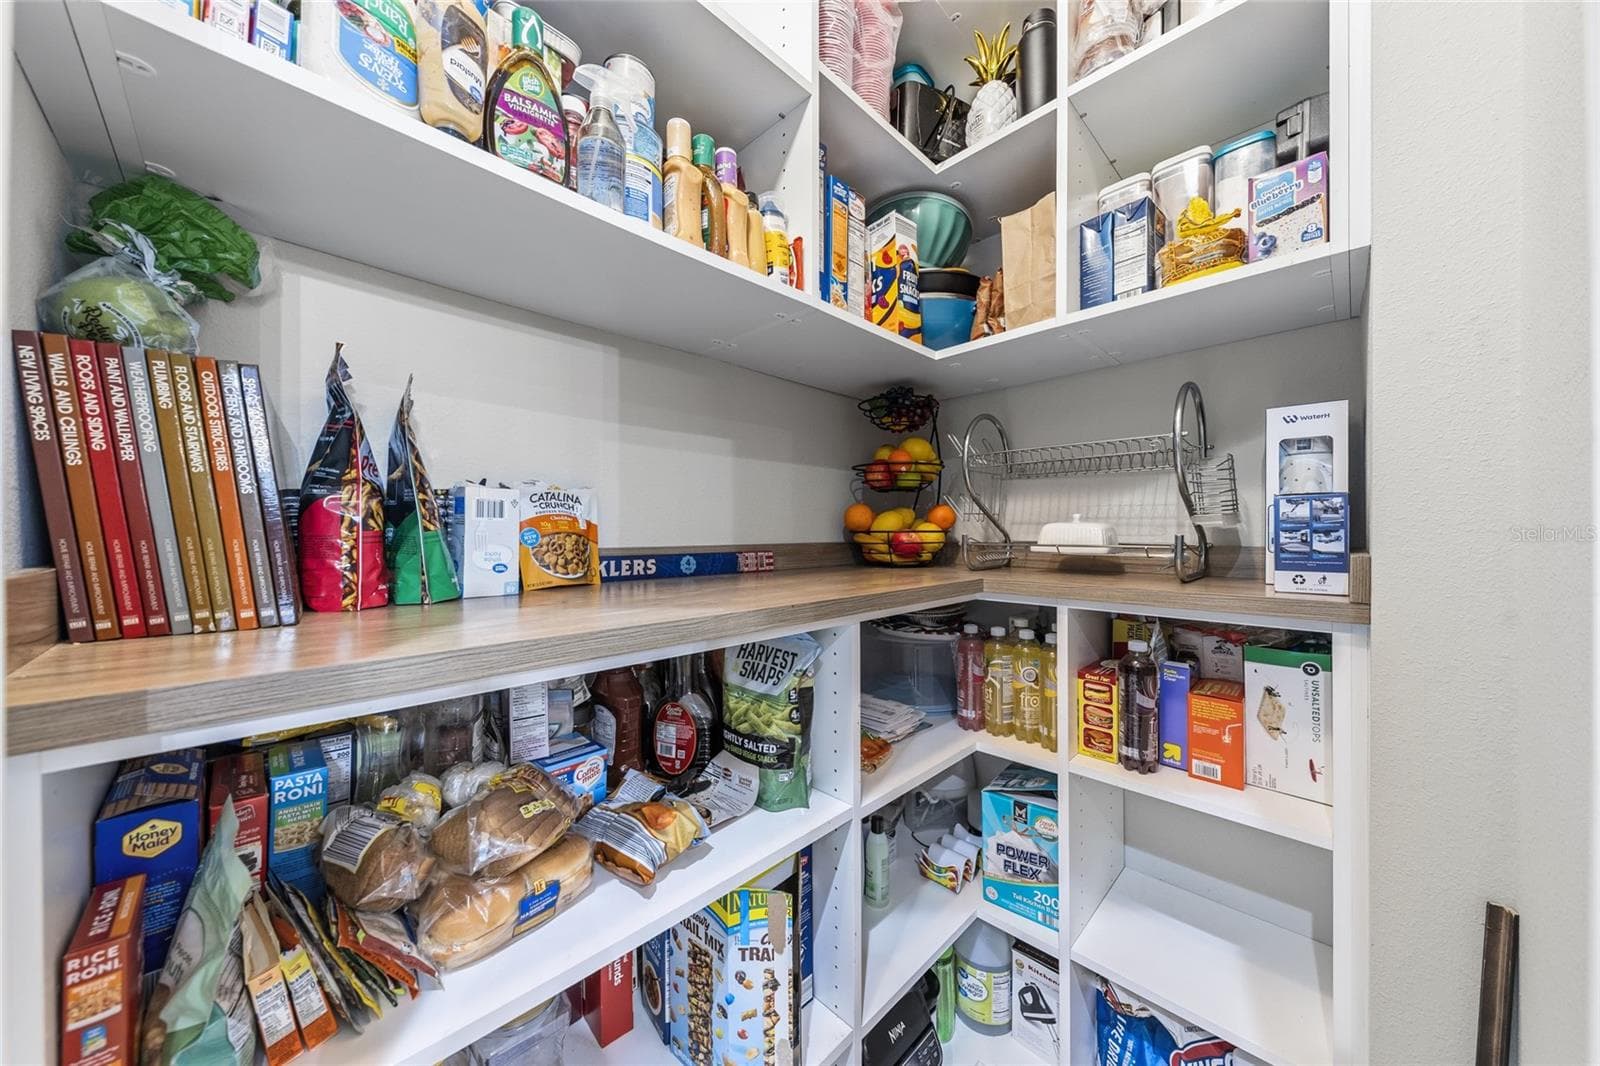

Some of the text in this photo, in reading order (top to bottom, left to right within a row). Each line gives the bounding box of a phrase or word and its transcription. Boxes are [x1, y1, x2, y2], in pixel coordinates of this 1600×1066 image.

[358, 53, 407, 94] KEN'S
[450, 58, 482, 88] Mustard
[503, 92, 559, 124] BALSAMIC
[508, 102, 555, 127] VINAIGRETTE
[1250, 181, 1303, 210] Blueberry
[16, 344, 51, 441] NEW LIVING SPACES
[152, 360, 173, 410] PLUMBING
[48, 352, 83, 466] WALLS AND CEILINGS
[74, 354, 107, 451] ROOFS AND SIDING
[102, 356, 136, 461] PAINT AND WALLPAPER
[128, 360, 158, 452] WEATHERPROOFING
[173, 364, 205, 473] FLOORS AND STAIRWAYS
[200, 370, 229, 472] OUTDOOR STRUCTURES
[228, 416, 244, 438] AND
[232, 438, 253, 494] BATHROOMS
[529, 491, 582, 505] CATALINA
[539, 502, 574, 511] CRUNCH
[736, 642, 798, 672] HARVEST
[739, 660, 784, 686] SNAPS
[743, 739, 777, 754] SALTED
[275, 772, 324, 791] PASTA
[576, 763, 600, 781] Coffee
[582, 769, 601, 784] mate
[274, 783, 323, 804] RONI
[128, 826, 178, 845] Honey
[132, 836, 169, 853] Maid
[996, 843, 1048, 869] POWER
[1004, 859, 1042, 883] FLEX
[1033, 890, 1059, 910] 200
[705, 931, 724, 957] MIX
[66, 945, 119, 972] RICE
[888, 1020, 907, 1044] NINJA
